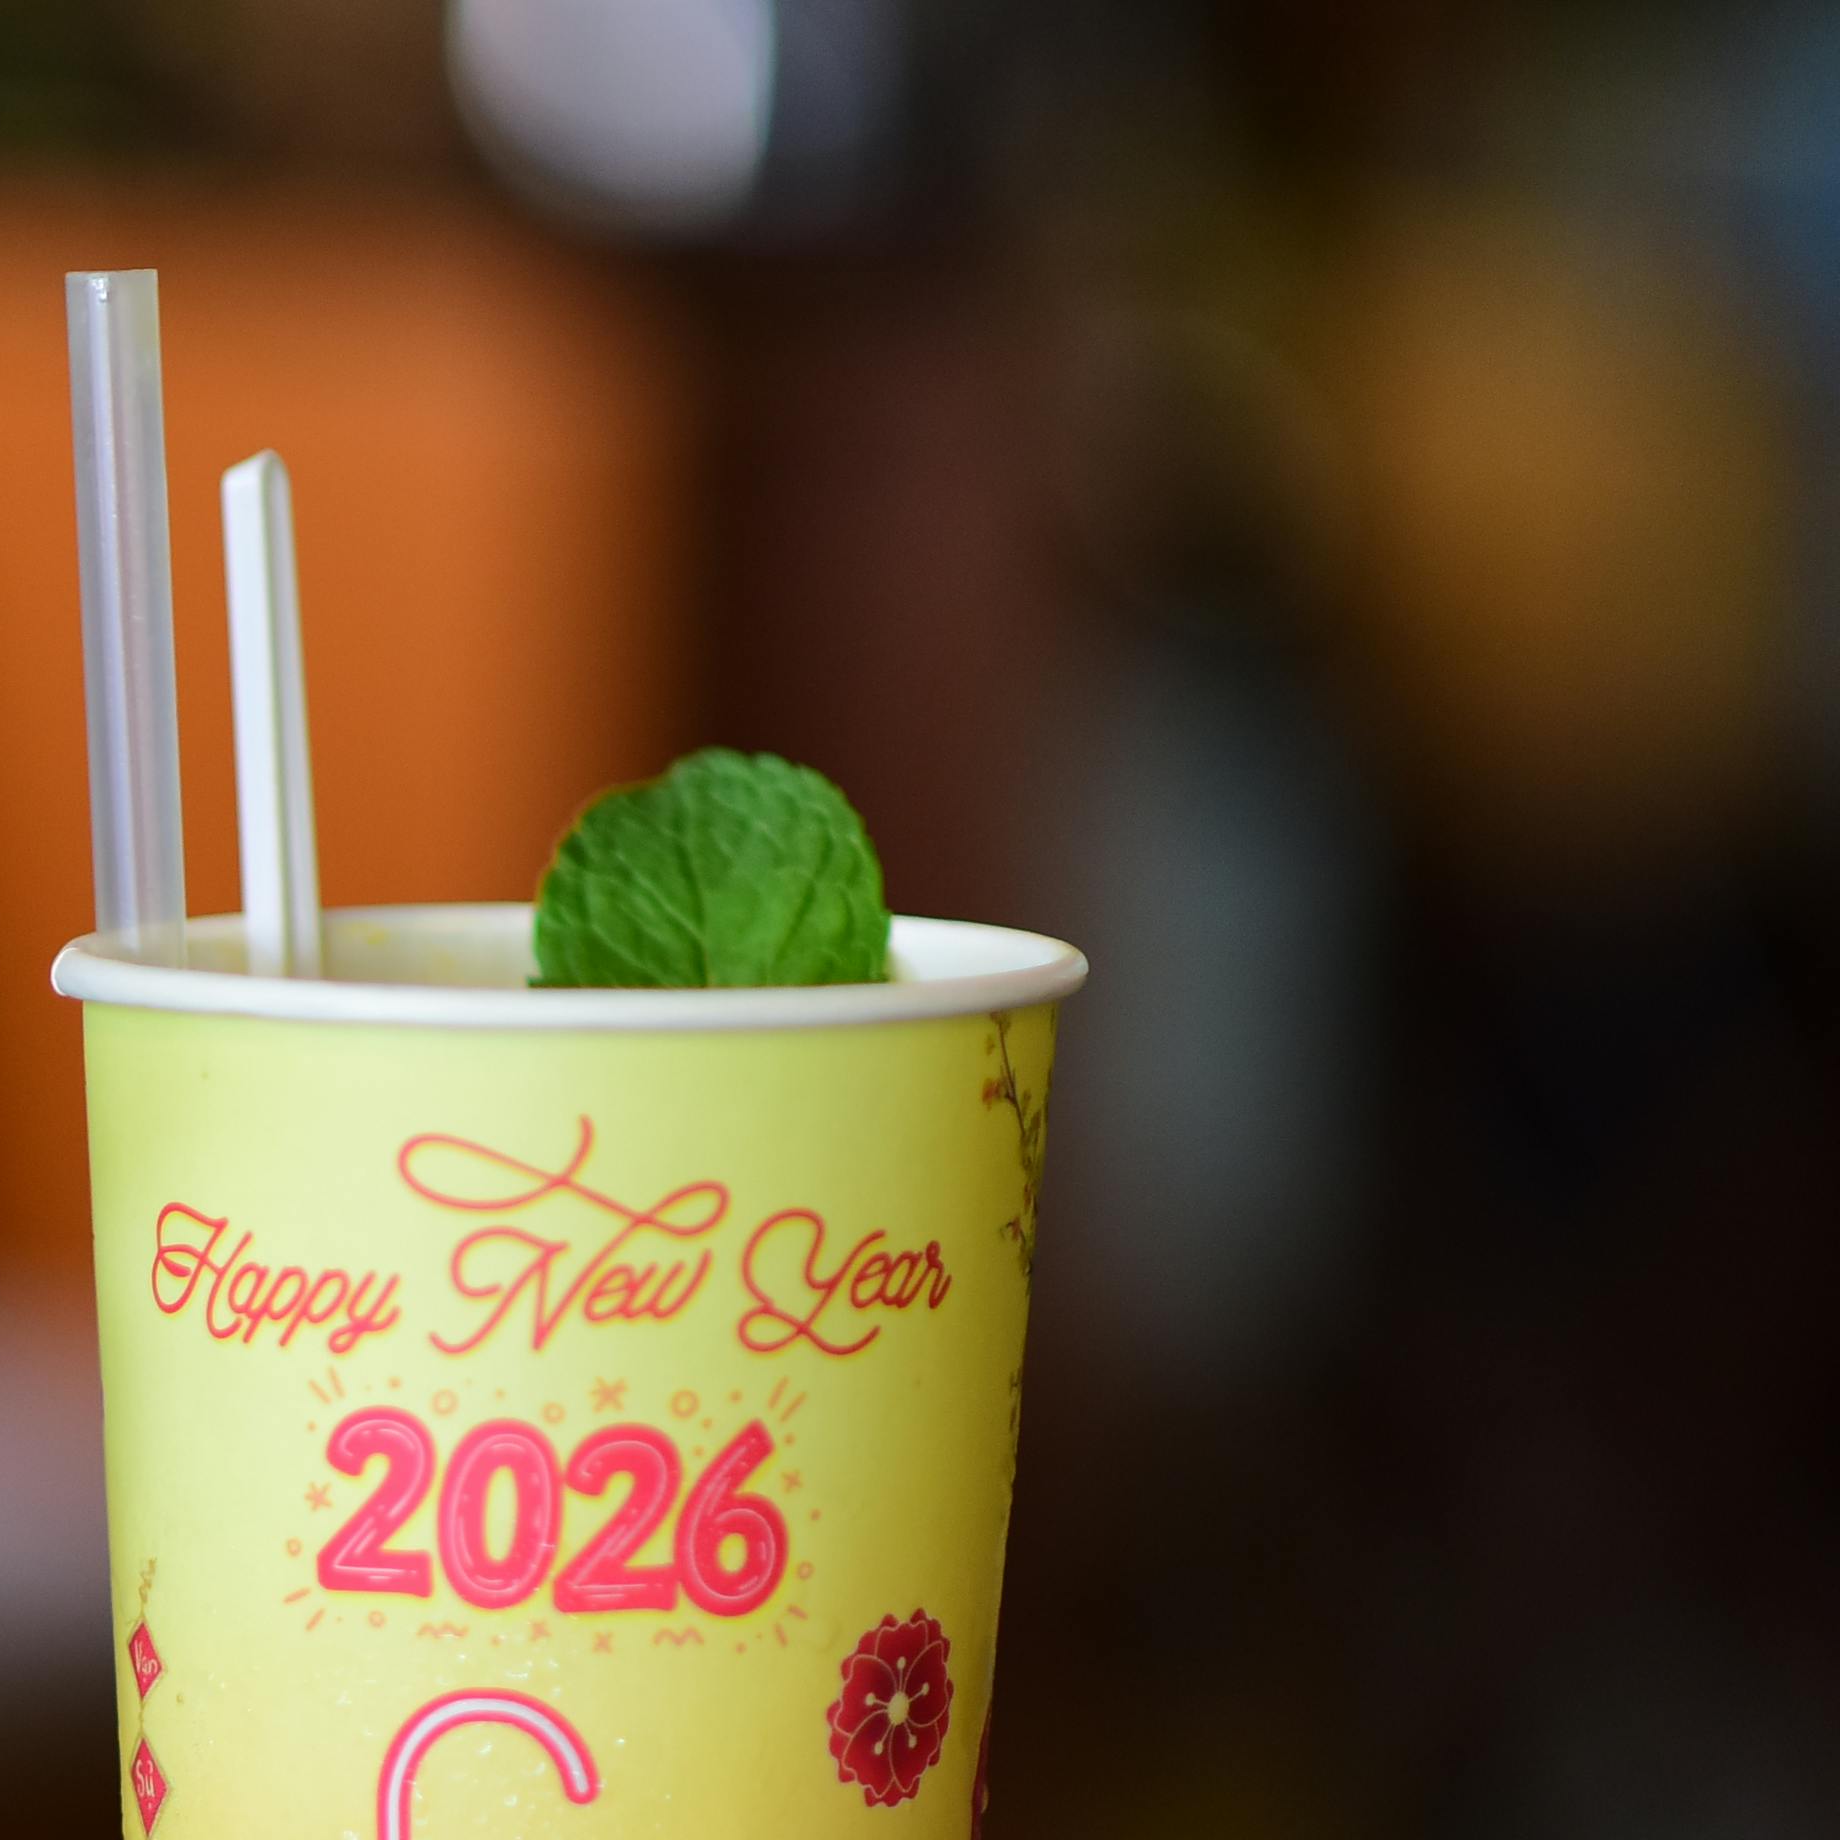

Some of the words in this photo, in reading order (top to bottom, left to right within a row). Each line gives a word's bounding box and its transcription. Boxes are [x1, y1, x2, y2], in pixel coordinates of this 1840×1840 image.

[151, 1201, 401, 1354] Happy
[397, 1113, 730, 1355] New
[737, 1208, 953, 1356] Year
[317, 1404, 790, 1618] 2026
